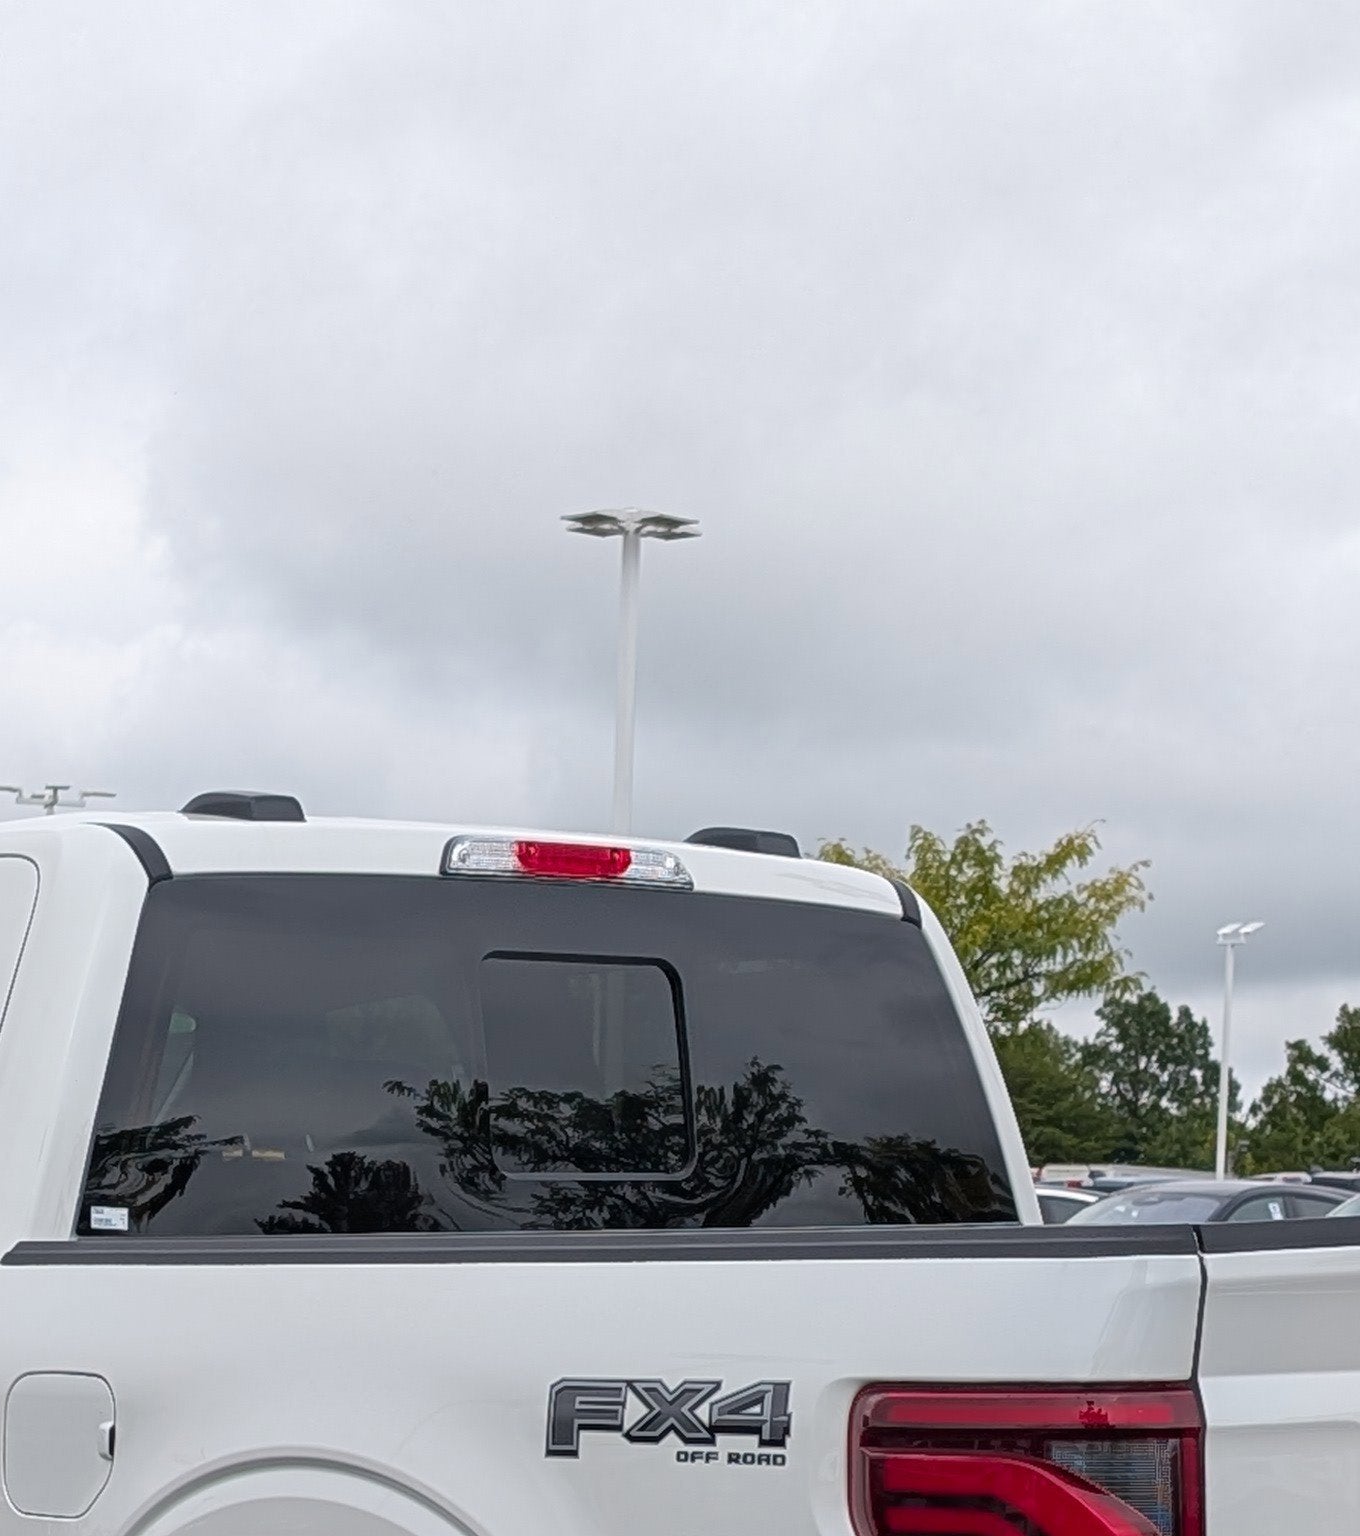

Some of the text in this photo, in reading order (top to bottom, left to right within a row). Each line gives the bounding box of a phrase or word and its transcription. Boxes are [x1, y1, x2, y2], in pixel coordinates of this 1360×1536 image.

[545, 1377, 792, 1458] FX4
[676, 1451, 786, 1466] OFF ROAD
